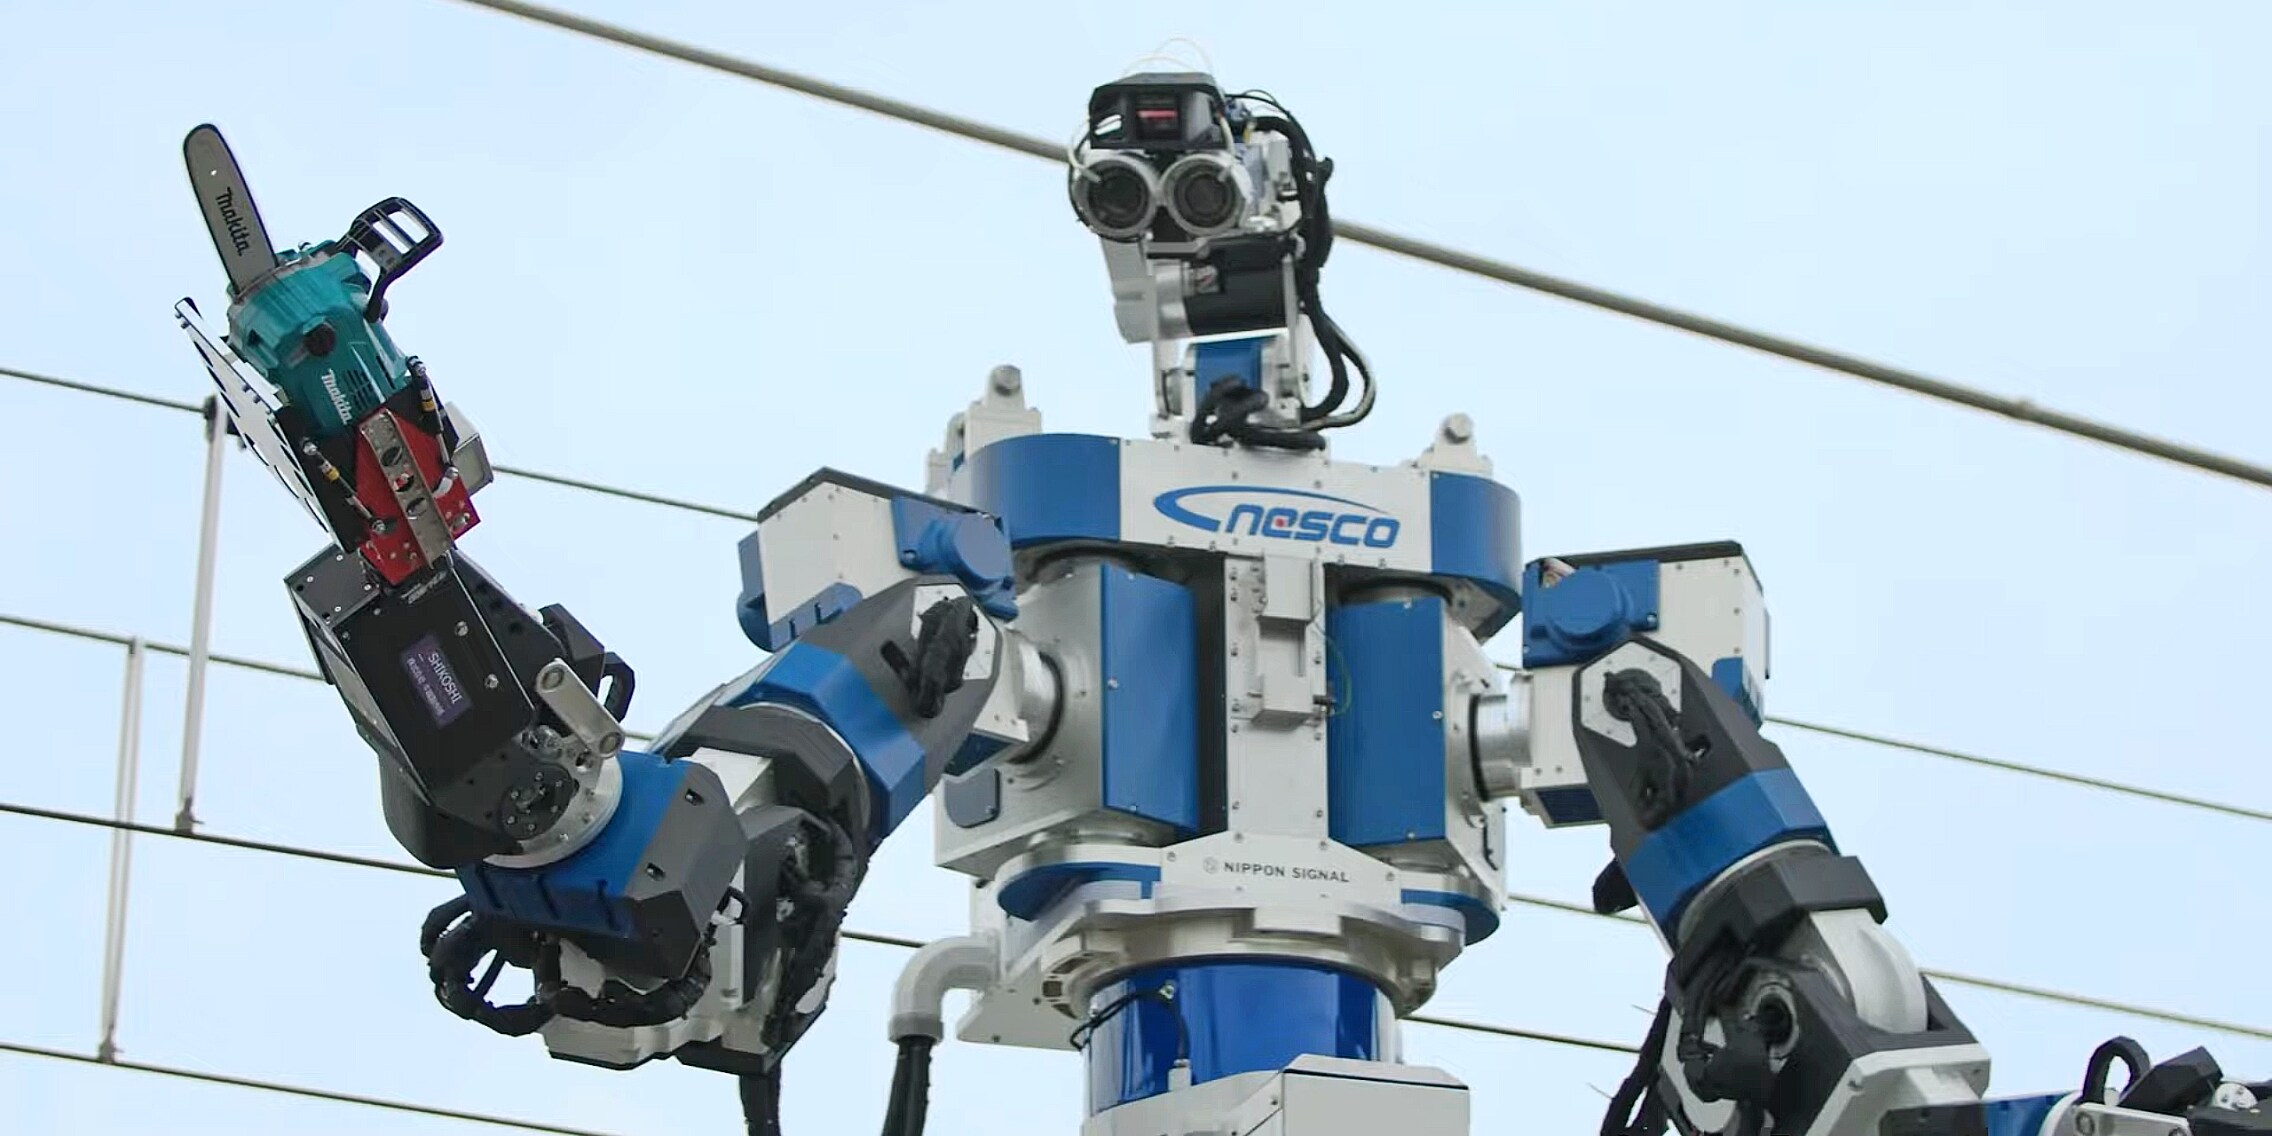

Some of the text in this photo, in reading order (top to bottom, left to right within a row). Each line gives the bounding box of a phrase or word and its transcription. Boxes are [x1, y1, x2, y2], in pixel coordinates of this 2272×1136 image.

[1225, 504, 1401, 548] nesco
[428, 652, 463, 704] SHIKOSHI
[1224, 862, 1350, 882] NIPPON SIGNAL
